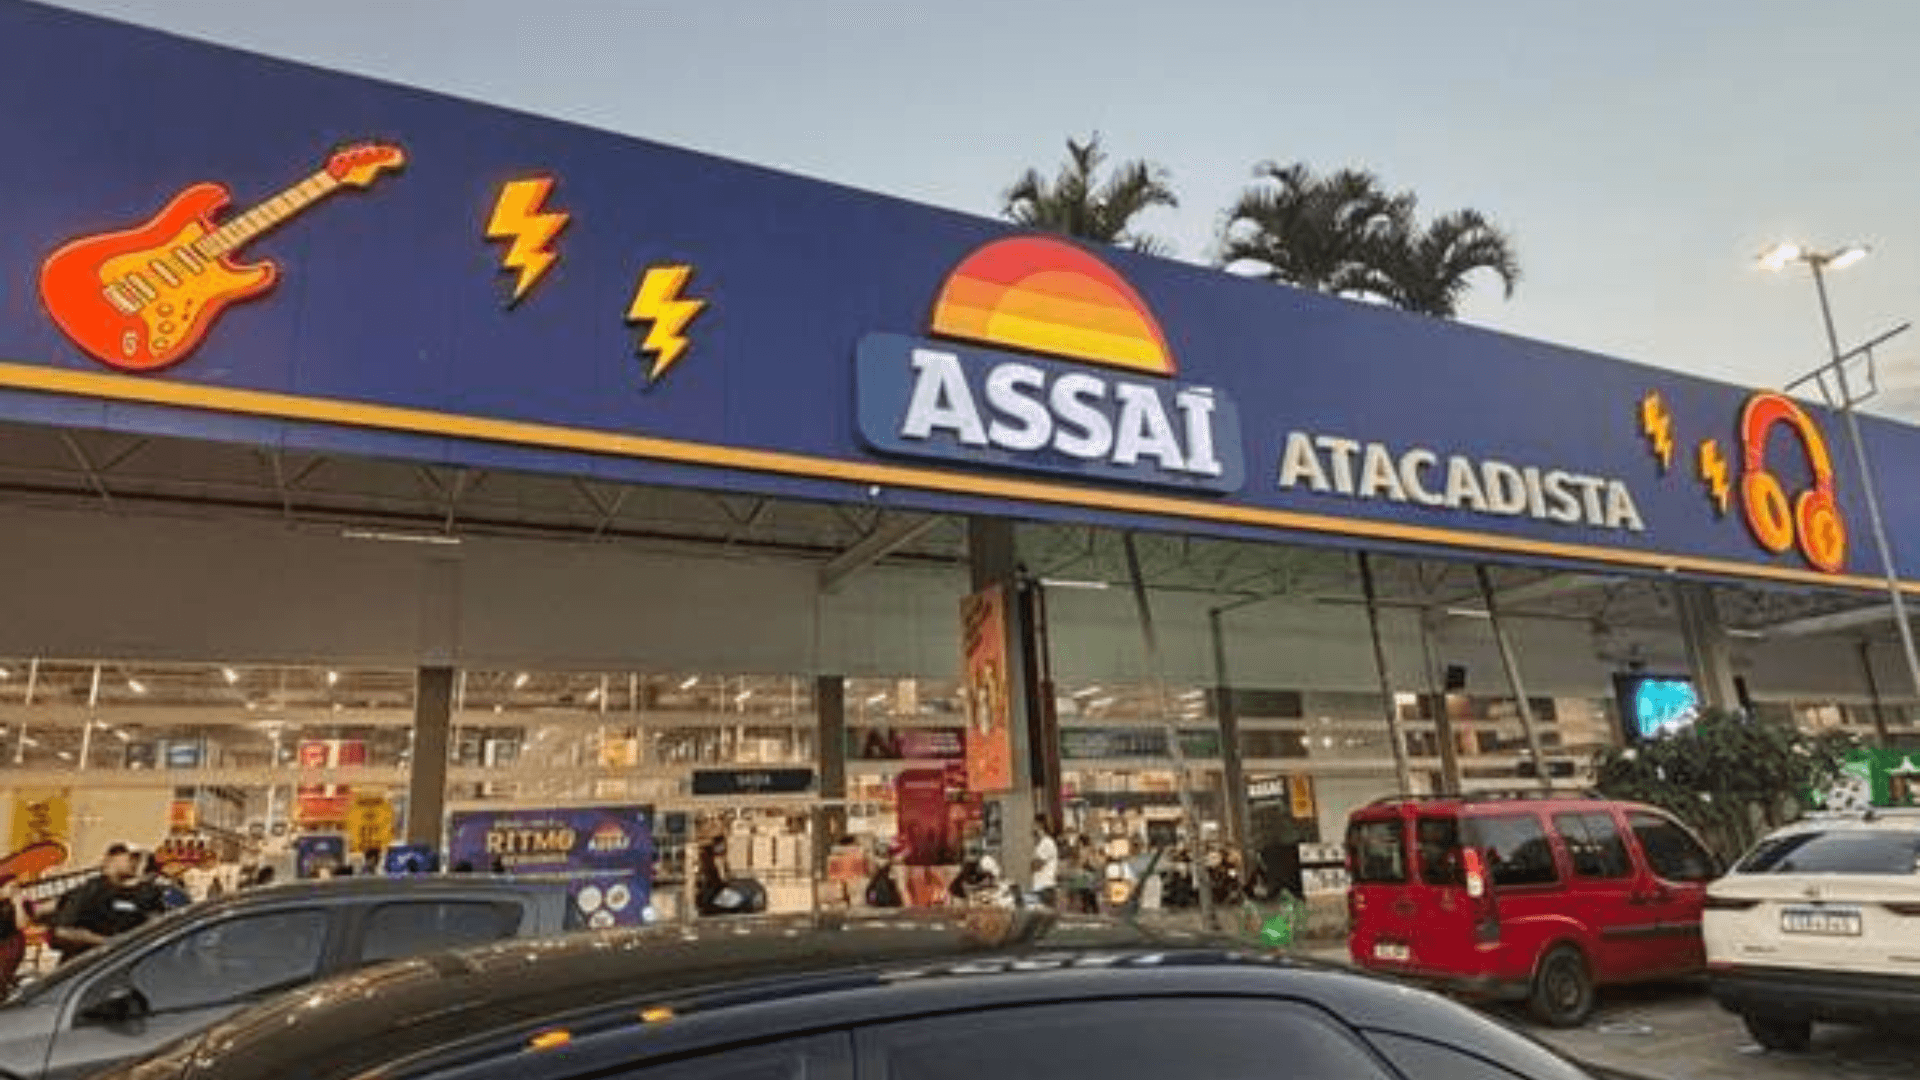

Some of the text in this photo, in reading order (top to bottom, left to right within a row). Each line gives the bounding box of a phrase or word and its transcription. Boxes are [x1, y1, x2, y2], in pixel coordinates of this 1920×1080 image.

[901, 348, 1222, 476] ASSAÍ
[1279, 431, 1644, 531] ATACADISTA
[487, 828, 576, 853] RITMO
